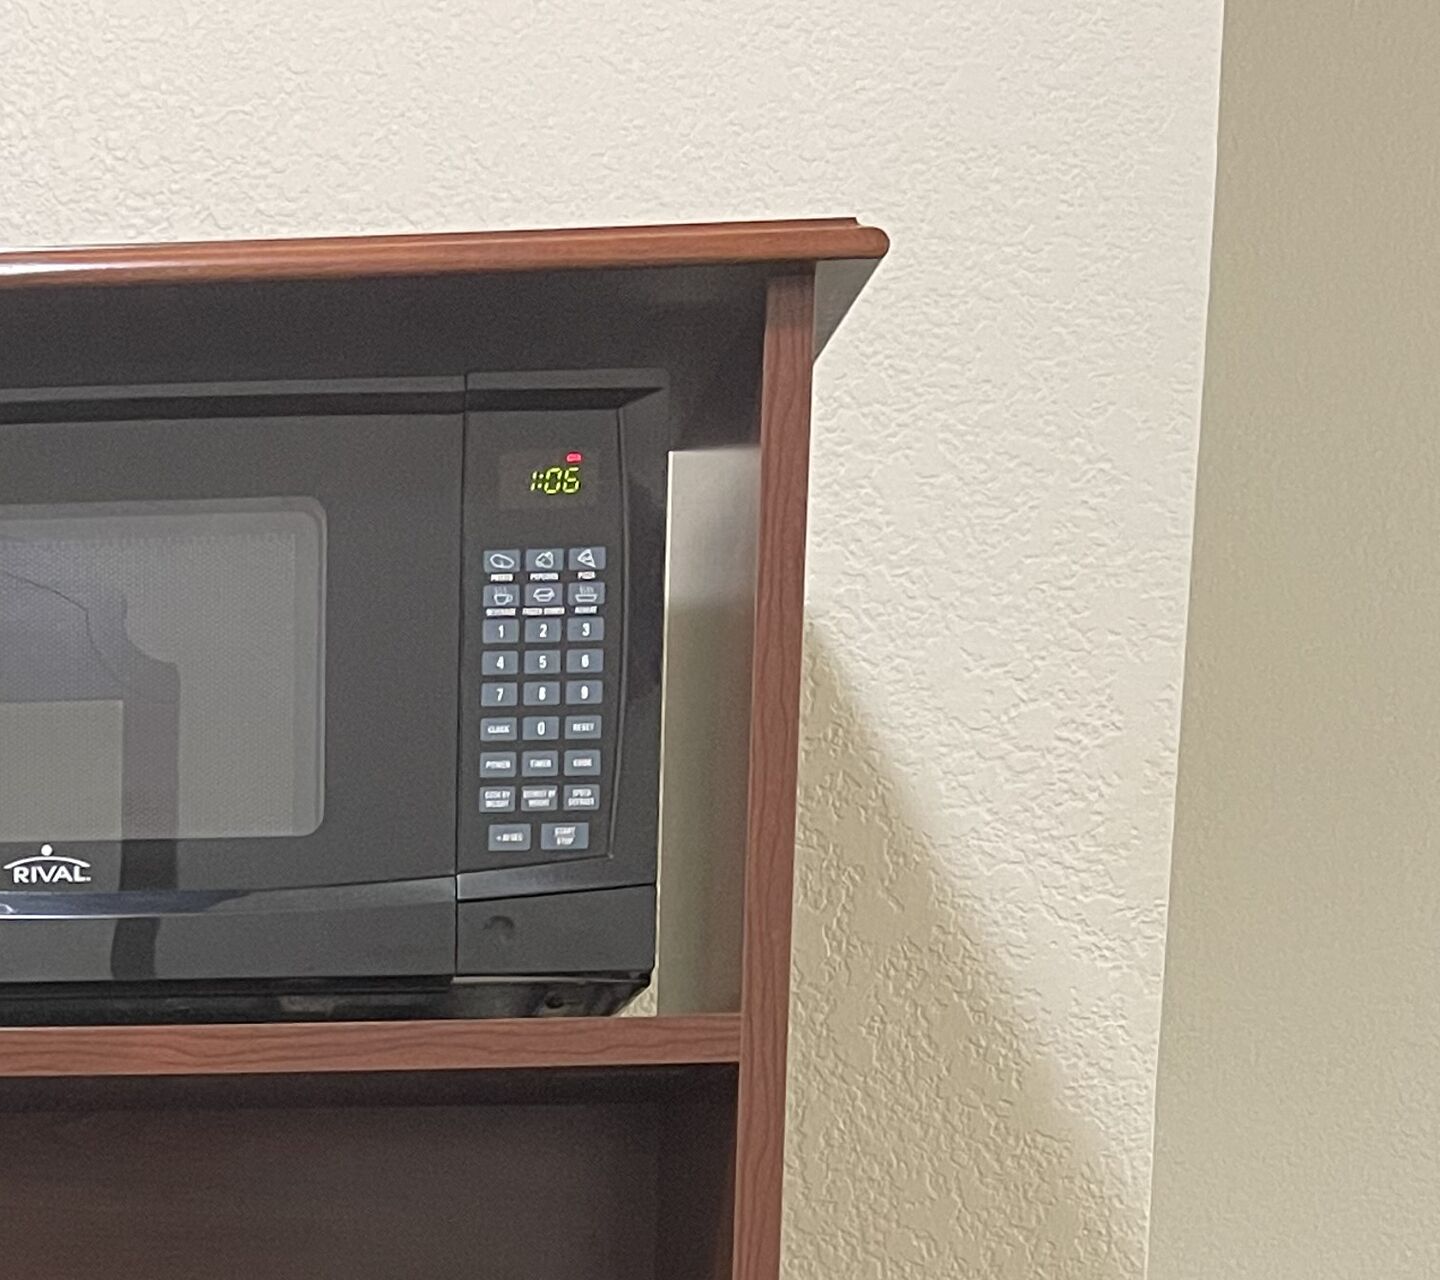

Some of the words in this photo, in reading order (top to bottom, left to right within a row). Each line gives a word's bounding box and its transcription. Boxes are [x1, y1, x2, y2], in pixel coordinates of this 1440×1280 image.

[530, 466, 580, 494] 1:06
[498, 624, 505, 638] 1
[539, 624, 548, 638] 2
[581, 623, 590, 637] 3
[496, 656, 505, 670] 4
[539, 655, 547, 669] 5
[581, 654, 590, 668] 6
[496, 688, 504, 702] 7
[538, 687, 546, 701] 8
[581, 686, 589, 700] 9
[487, 724, 510, 734] CLOCK
[536, 721, 546, 736] 0
[572, 722, 595, 732] RESET
[13, 865, 88, 884] RIVAL
